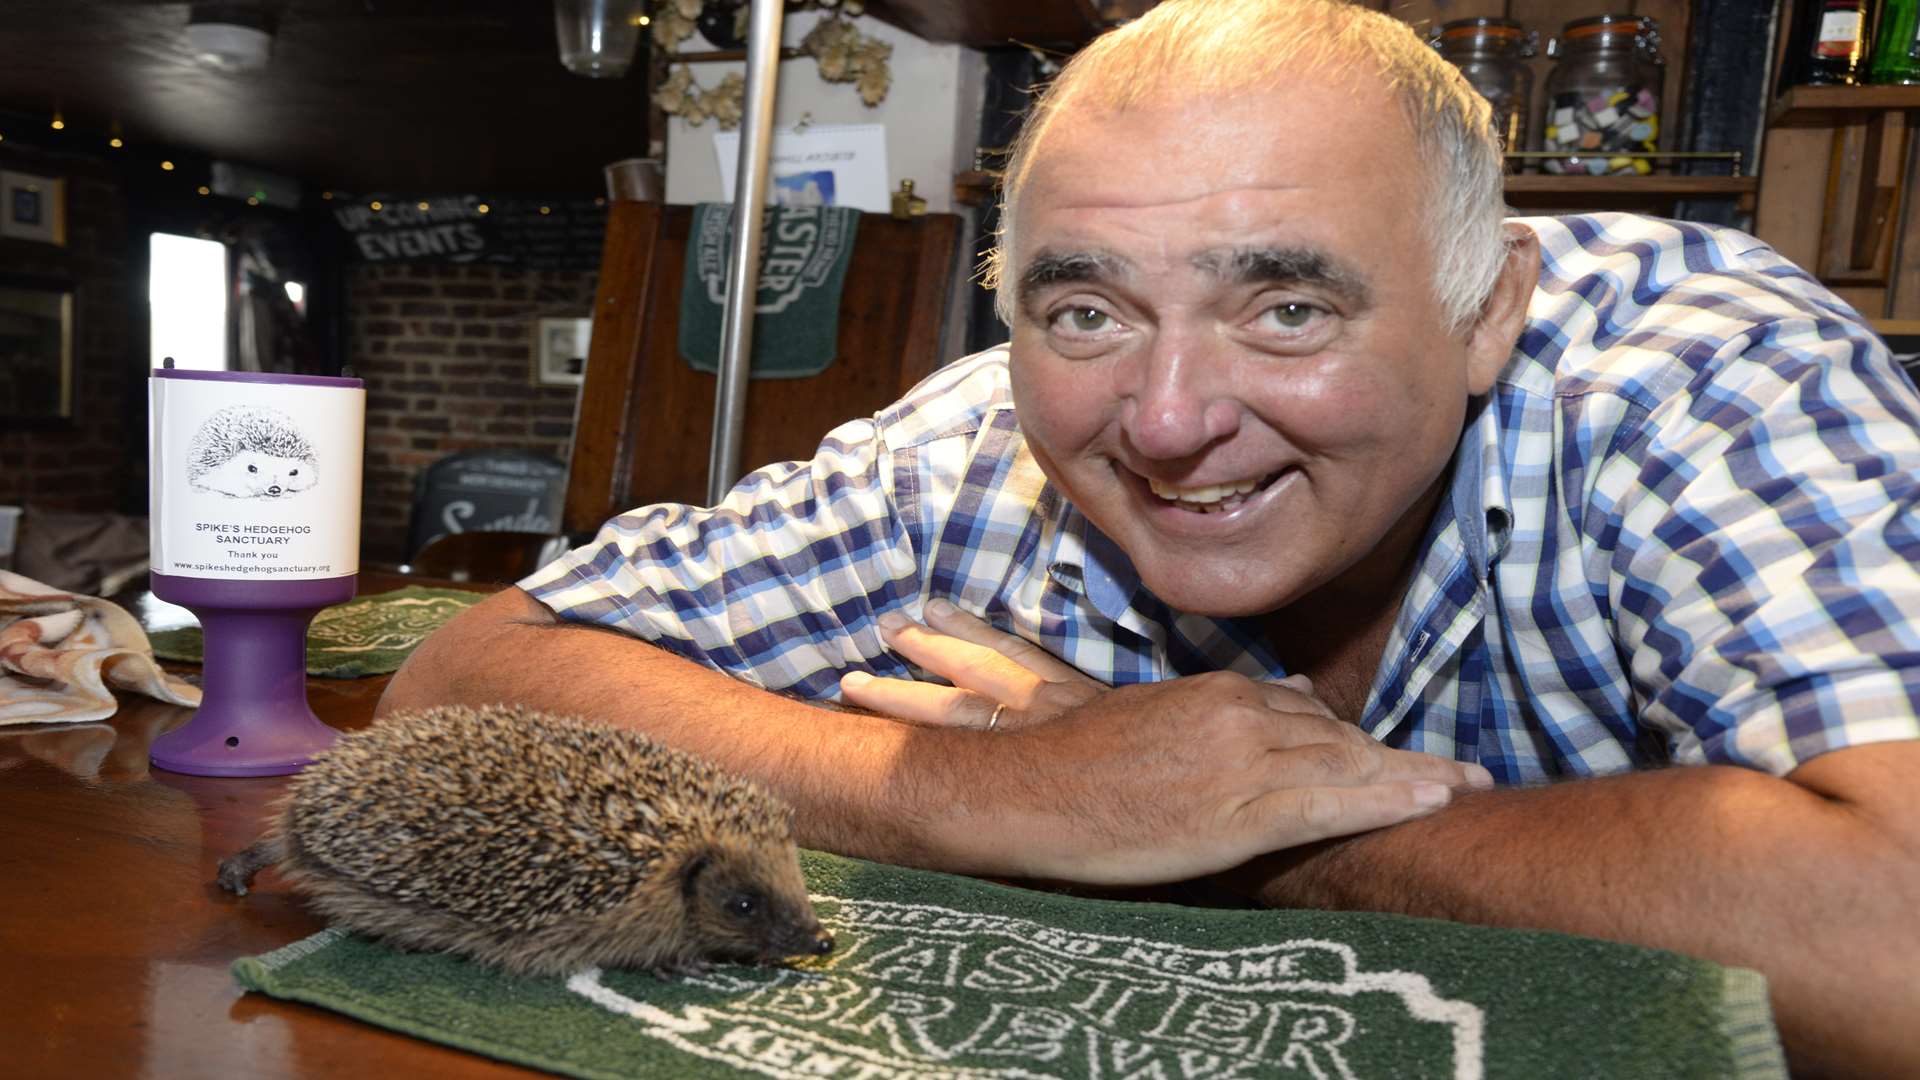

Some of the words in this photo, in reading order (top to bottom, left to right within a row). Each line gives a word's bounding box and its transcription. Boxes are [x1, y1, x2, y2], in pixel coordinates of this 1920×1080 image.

[356, 223, 484, 261] EVENTS
[195, 522, 240, 533] SPIKE'S
[244, 525, 311, 534] HEDGEHOG
[216, 535, 291, 544] SANCTUARY
[227, 550, 258, 559] Thank
[174, 561, 331, 574] www.spikeshedgehogsanctuary.org
[1121, 945, 1307, 979] NEAME
